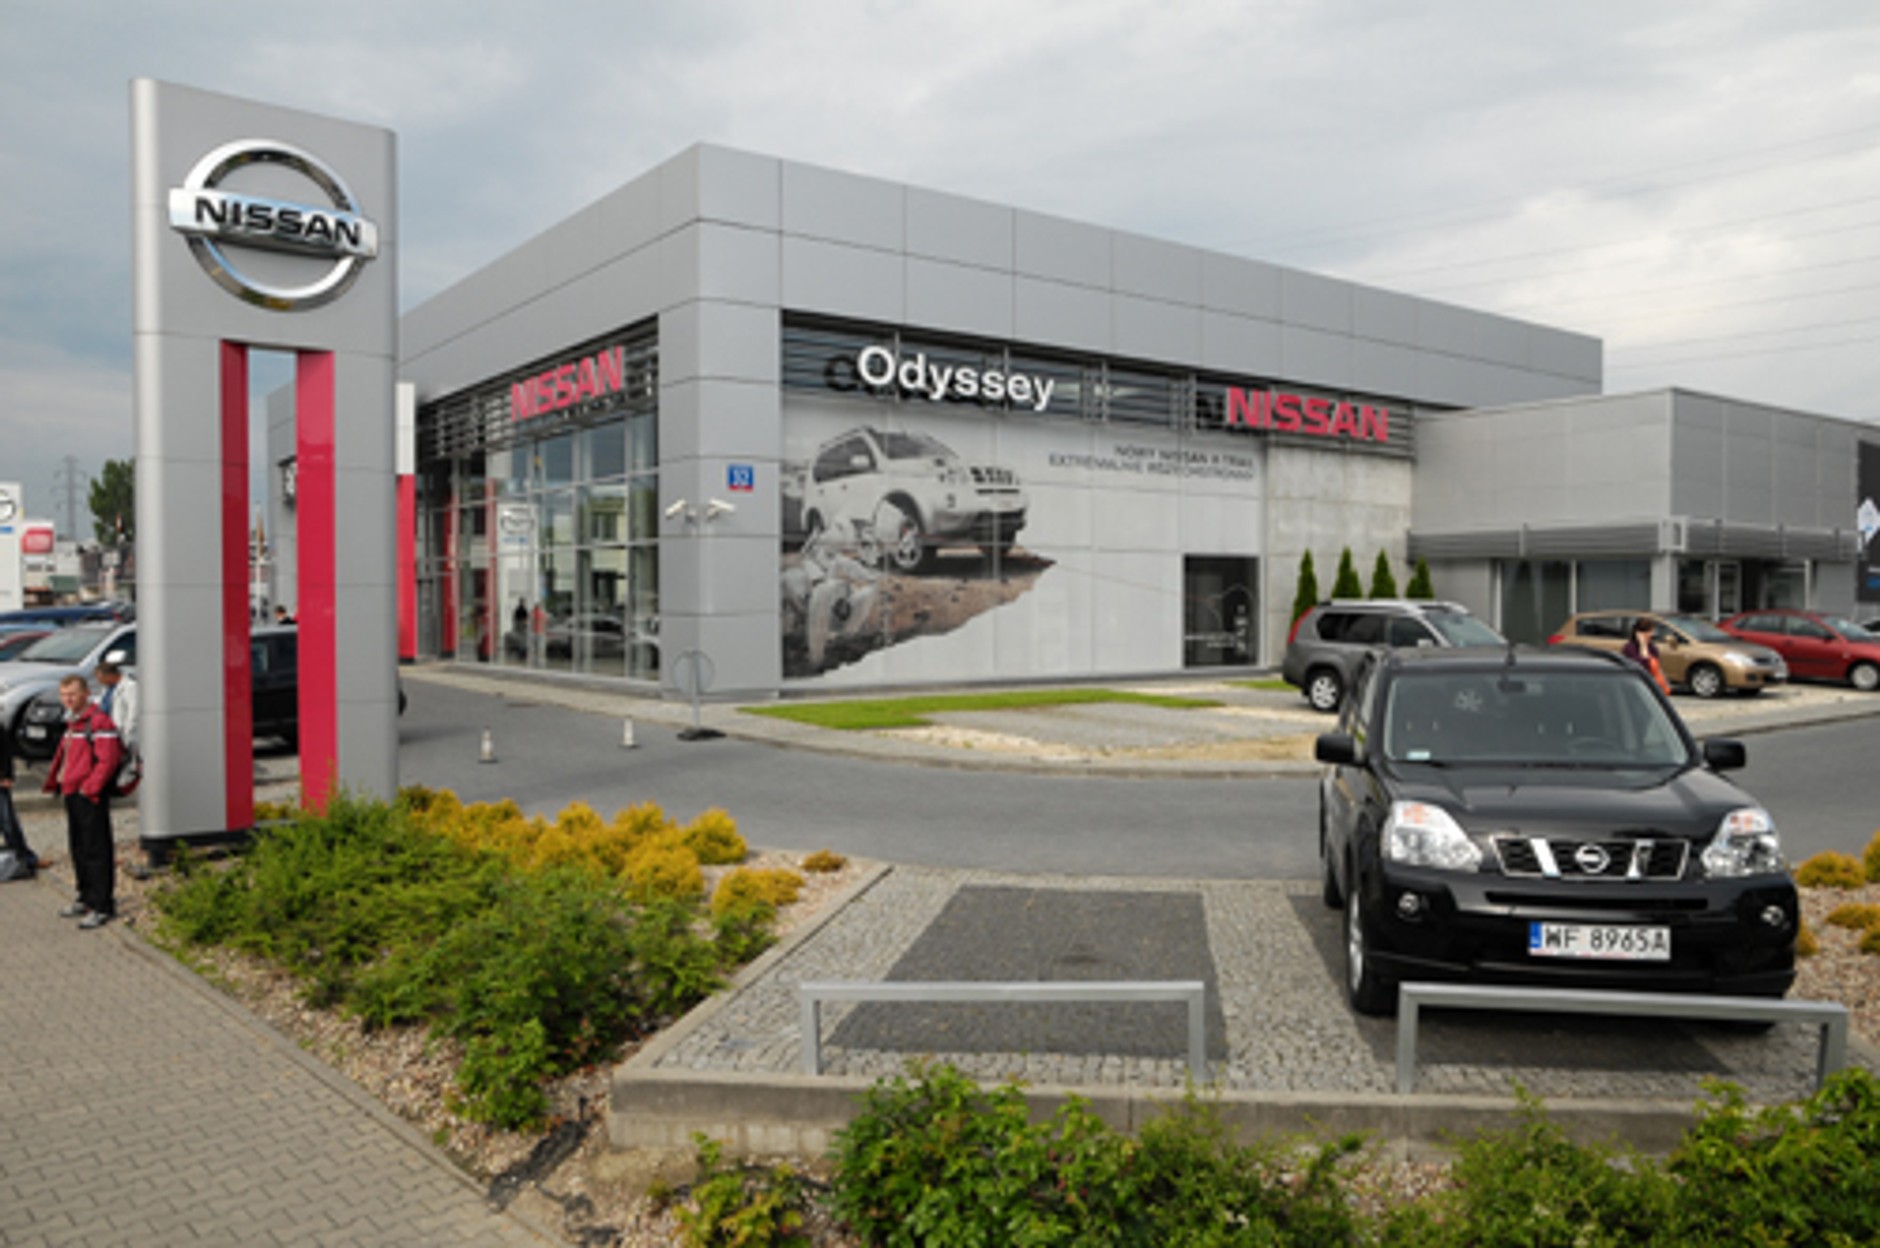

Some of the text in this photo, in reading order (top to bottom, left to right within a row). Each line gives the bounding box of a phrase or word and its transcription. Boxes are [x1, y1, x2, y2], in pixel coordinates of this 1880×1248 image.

[194, 196, 361, 247] NISSAN
[511, 345, 624, 424] NISSAN
[858, 345, 1055, 412] Odyssey
[1226, 385, 1390, 442] NISSAN
[1545, 928, 1667, 952] WF 8965A
